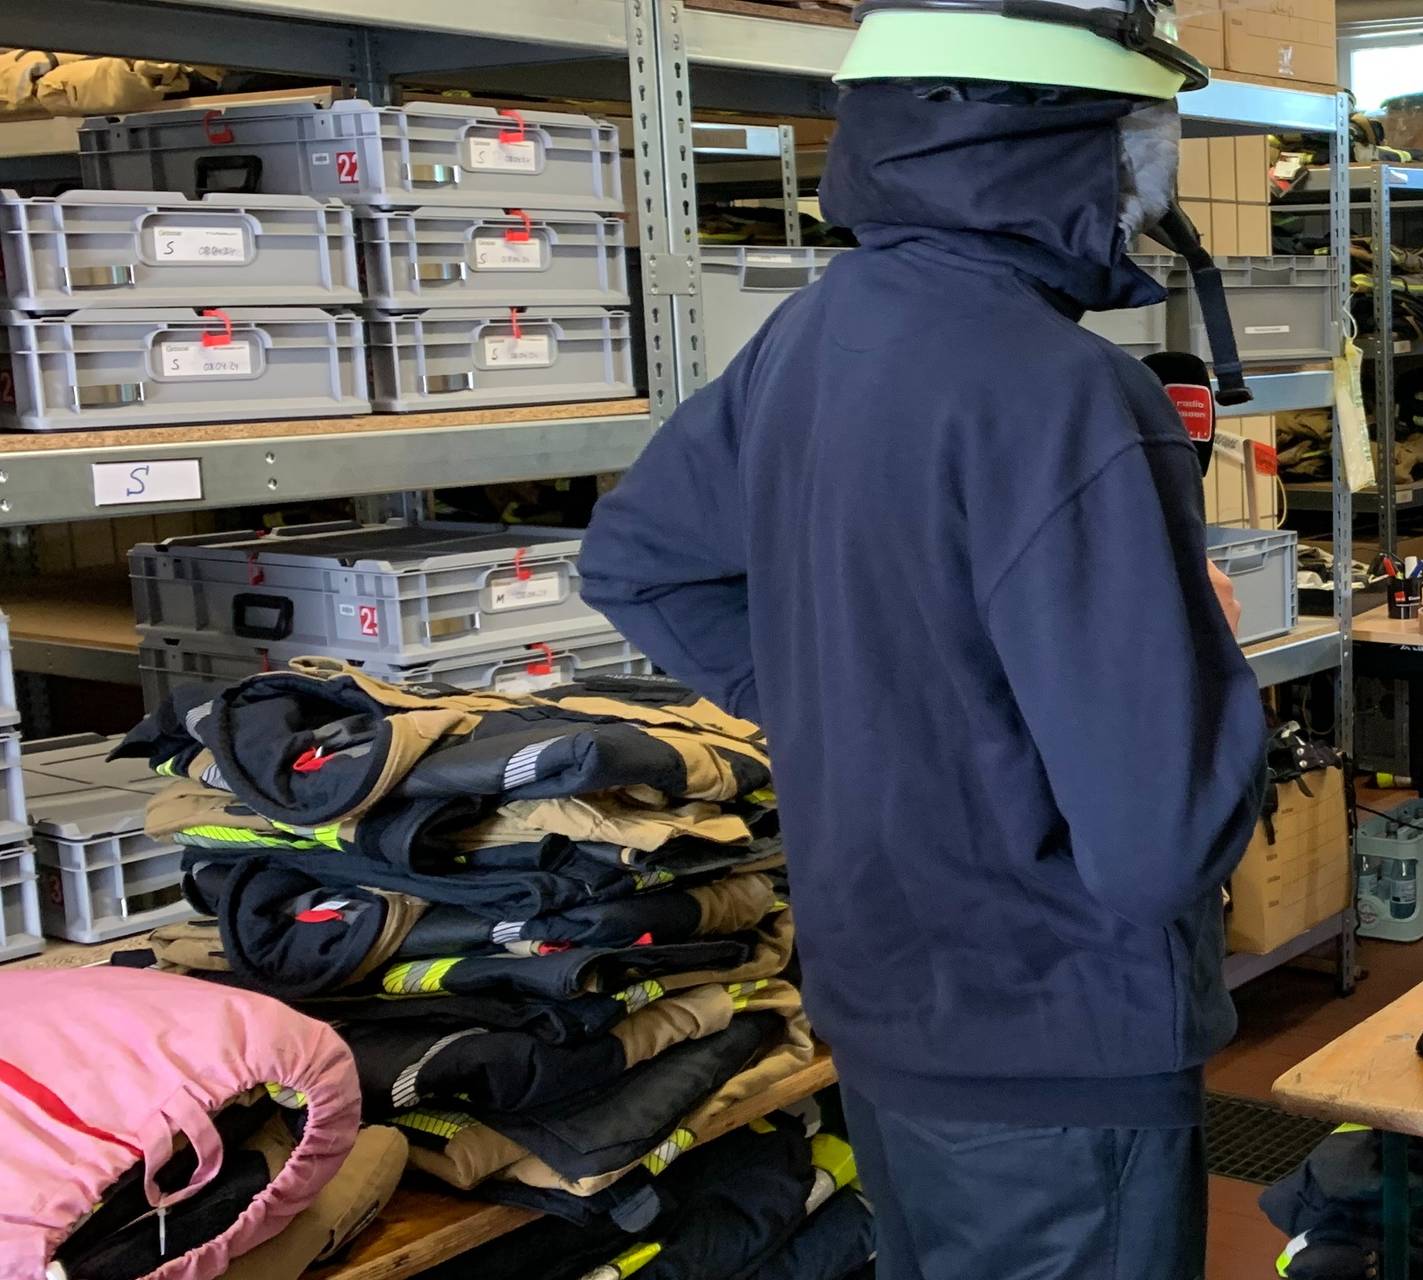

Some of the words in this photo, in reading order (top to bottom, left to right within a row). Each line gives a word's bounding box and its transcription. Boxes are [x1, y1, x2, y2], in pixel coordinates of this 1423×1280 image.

[163, 241, 174, 255] S
[478, 253, 487, 264] S
[491, 348, 498, 360] S
[171, 359, 180, 370] S
[1176, 400, 1204, 408] radio
[126, 465, 149, 496] S
[496, 594, 504, 603] M
